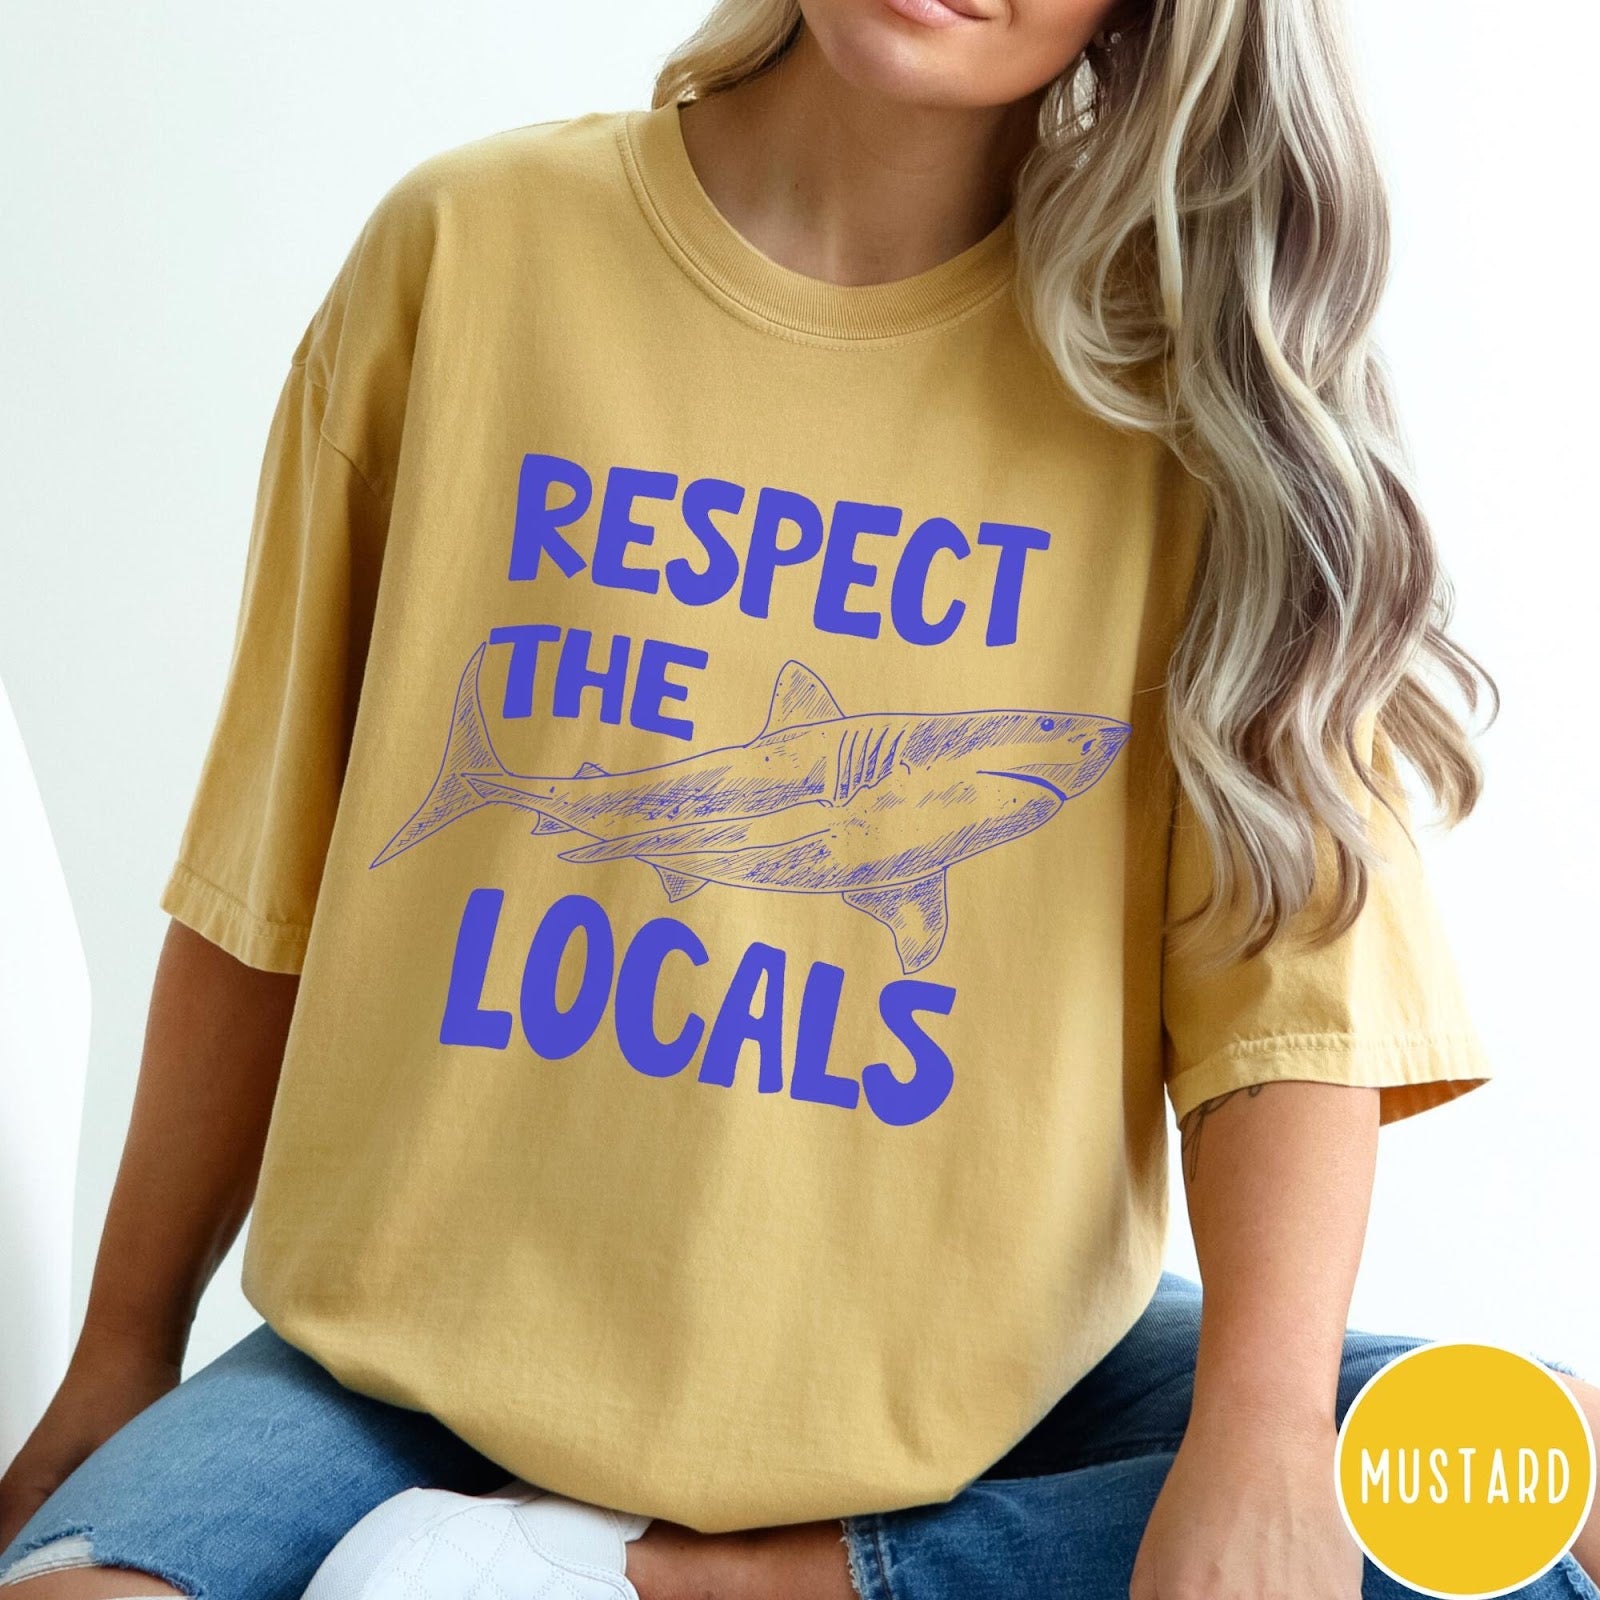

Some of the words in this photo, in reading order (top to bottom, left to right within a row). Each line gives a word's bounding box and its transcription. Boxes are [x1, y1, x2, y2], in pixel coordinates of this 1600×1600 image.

[508, 454, 1050, 647] RESPECT
[489, 625, 709, 741] THE
[439, 888, 956, 1127] LOCALS
